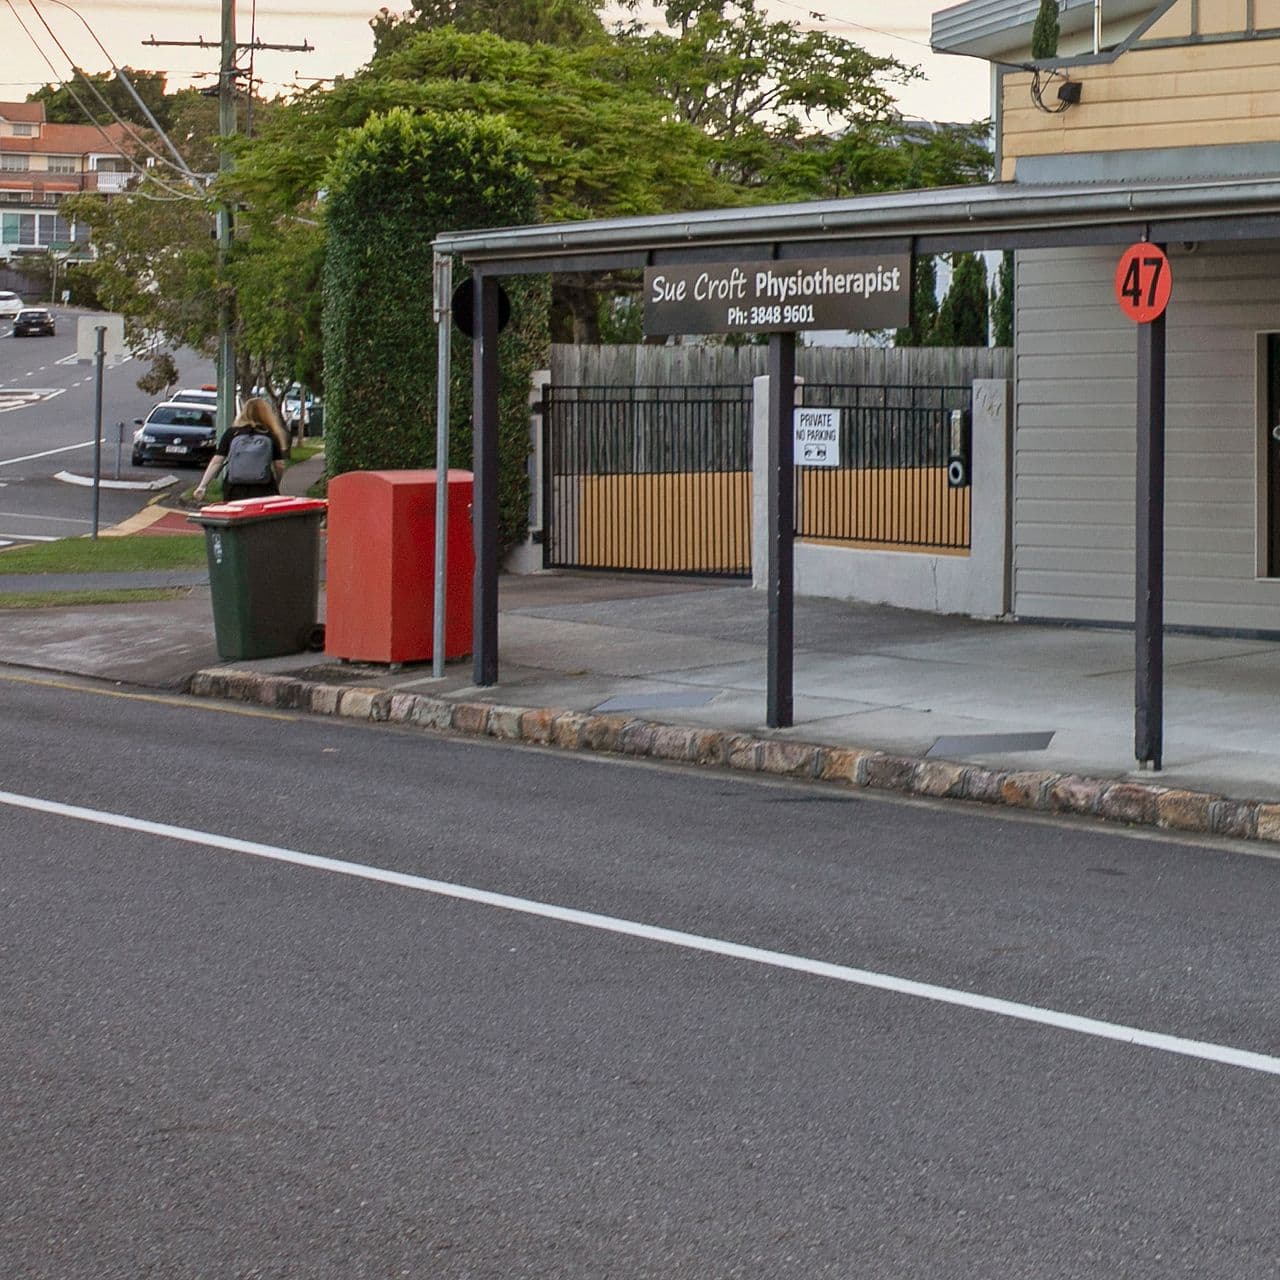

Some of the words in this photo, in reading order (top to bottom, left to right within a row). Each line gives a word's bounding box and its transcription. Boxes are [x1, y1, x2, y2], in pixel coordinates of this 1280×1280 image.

[651, 275, 687, 303] Sue
[693, 267, 747, 301] Croft
[755, 265, 901, 302] Physiotherapist
[1121, 257, 1163, 307] 47
[727, 306, 748, 325] Ph:
[750, 306, 782, 324] 3848
[783, 304, 815, 323] 9601
[800, 413, 832, 427] PRIVATE
[796, 430, 805, 441] NO
[807, 429, 836, 441] PARKING
